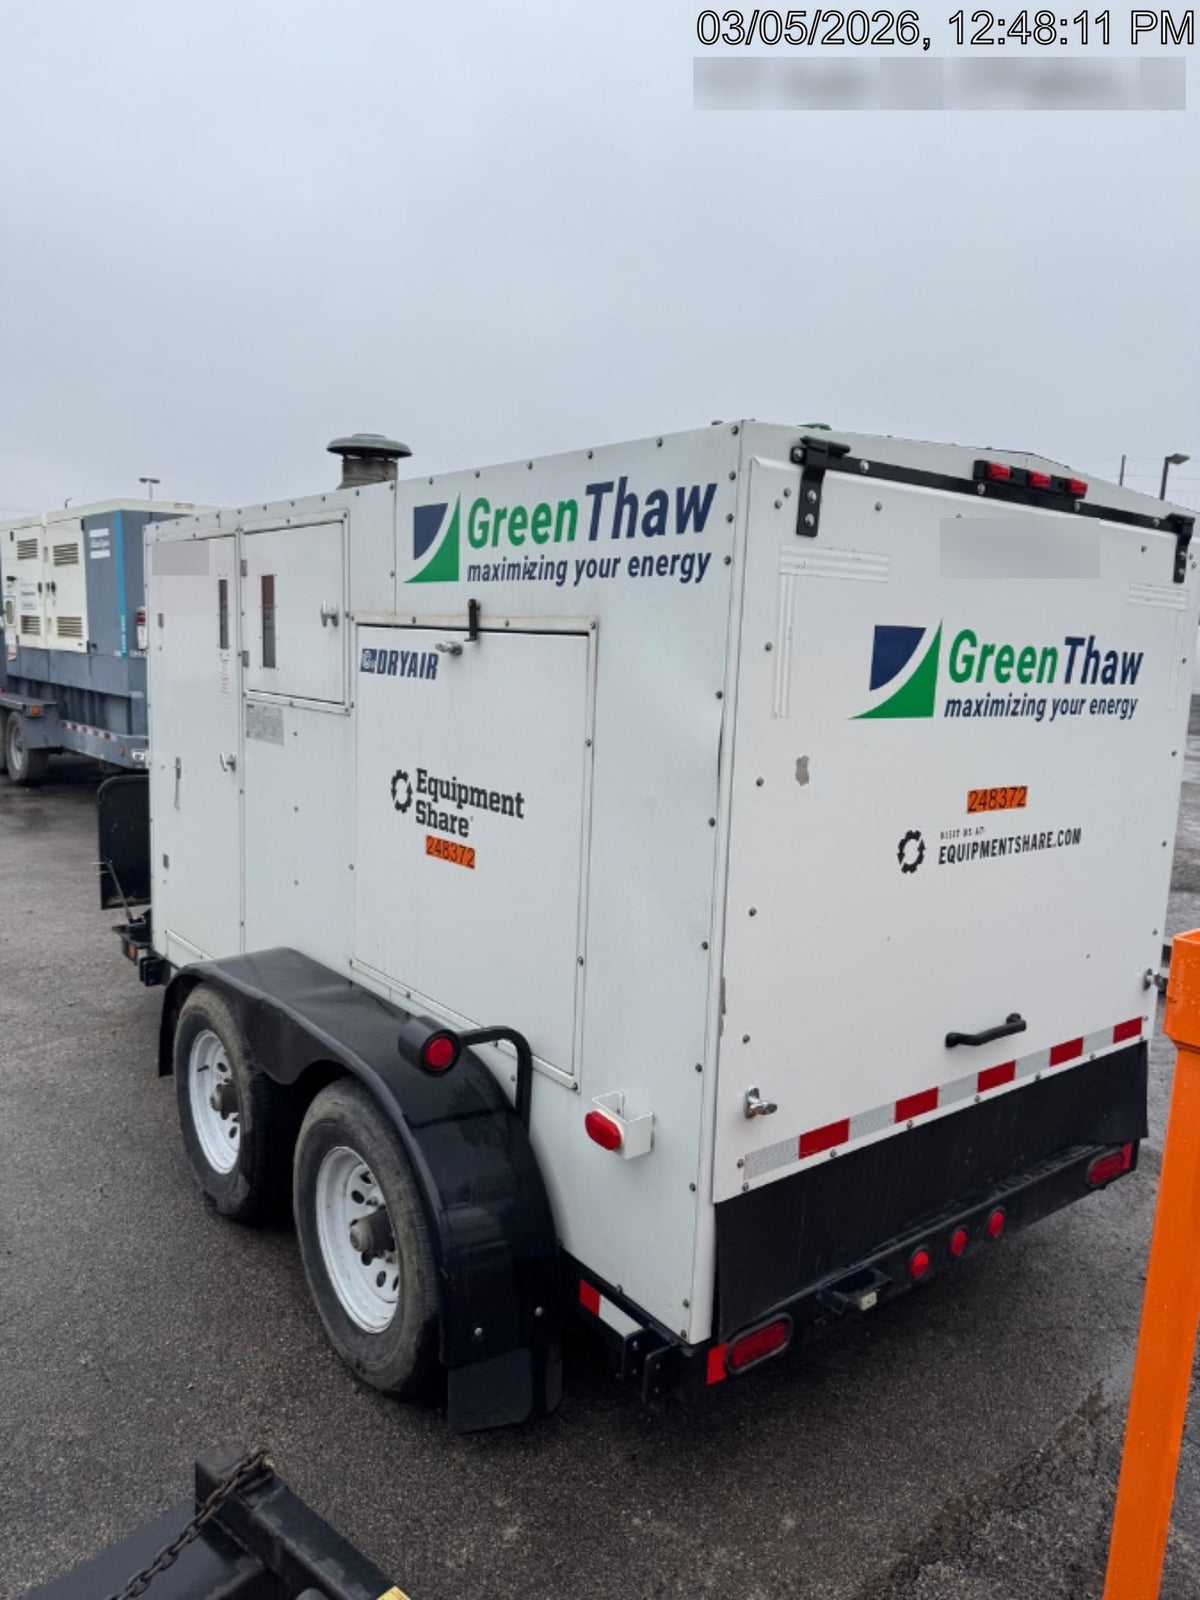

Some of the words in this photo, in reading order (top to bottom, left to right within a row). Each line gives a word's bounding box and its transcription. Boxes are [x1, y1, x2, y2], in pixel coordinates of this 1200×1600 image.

[467, 554, 567, 587] maximizing
[574, 556, 621, 587] your
[628, 552, 712, 584] energy
[376, 648, 439, 680] DRYAIR
[943, 692, 1047, 722] maximizing
[1050, 698, 1087, 722] your
[1089, 697, 1139, 720] energy
[416, 767, 525, 819] Equipment
[967, 786, 1028, 813] 248372
[415, 799, 470, 838] Share
[426, 835, 475, 869] 248372
[938, 827, 1082, 865] EQUIPMENTSHARE.COM
